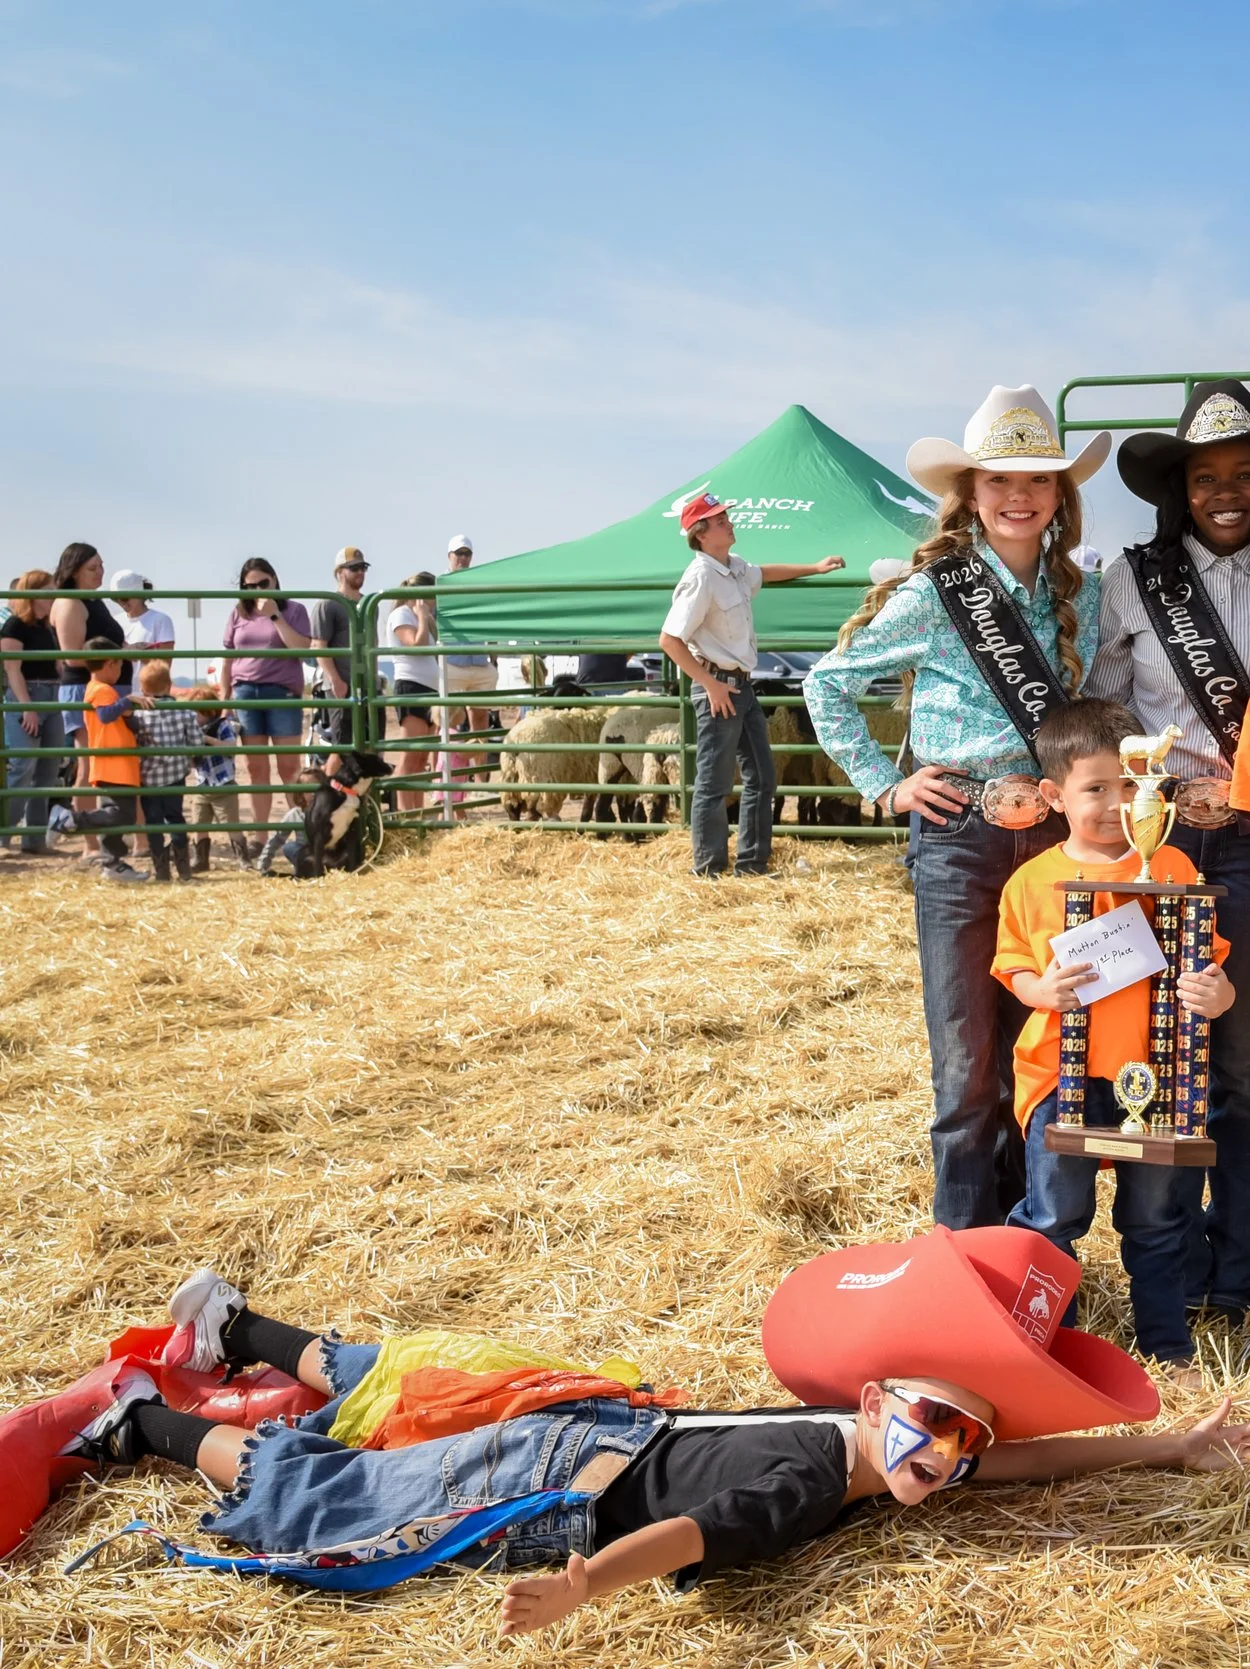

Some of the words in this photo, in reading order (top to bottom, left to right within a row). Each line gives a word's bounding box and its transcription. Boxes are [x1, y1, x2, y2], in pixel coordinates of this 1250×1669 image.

[729, 511, 768, 523] IFE
[939, 557, 982, 588] 2026
[957, 587, 1025, 684] Douglas
[1018, 682, 1049, 722] Co.
[1068, 939, 1099, 958] Mutton
[1112, 947, 1134, 964] Place
[1062, 1013, 1087, 1027] 2025
[1061, 1038, 1086, 1052] 2025
[1060, 1063, 1085, 1077] 2025
[1059, 1088, 1085, 1102] 2025
[1058, 1112, 1084, 1125] 2025
